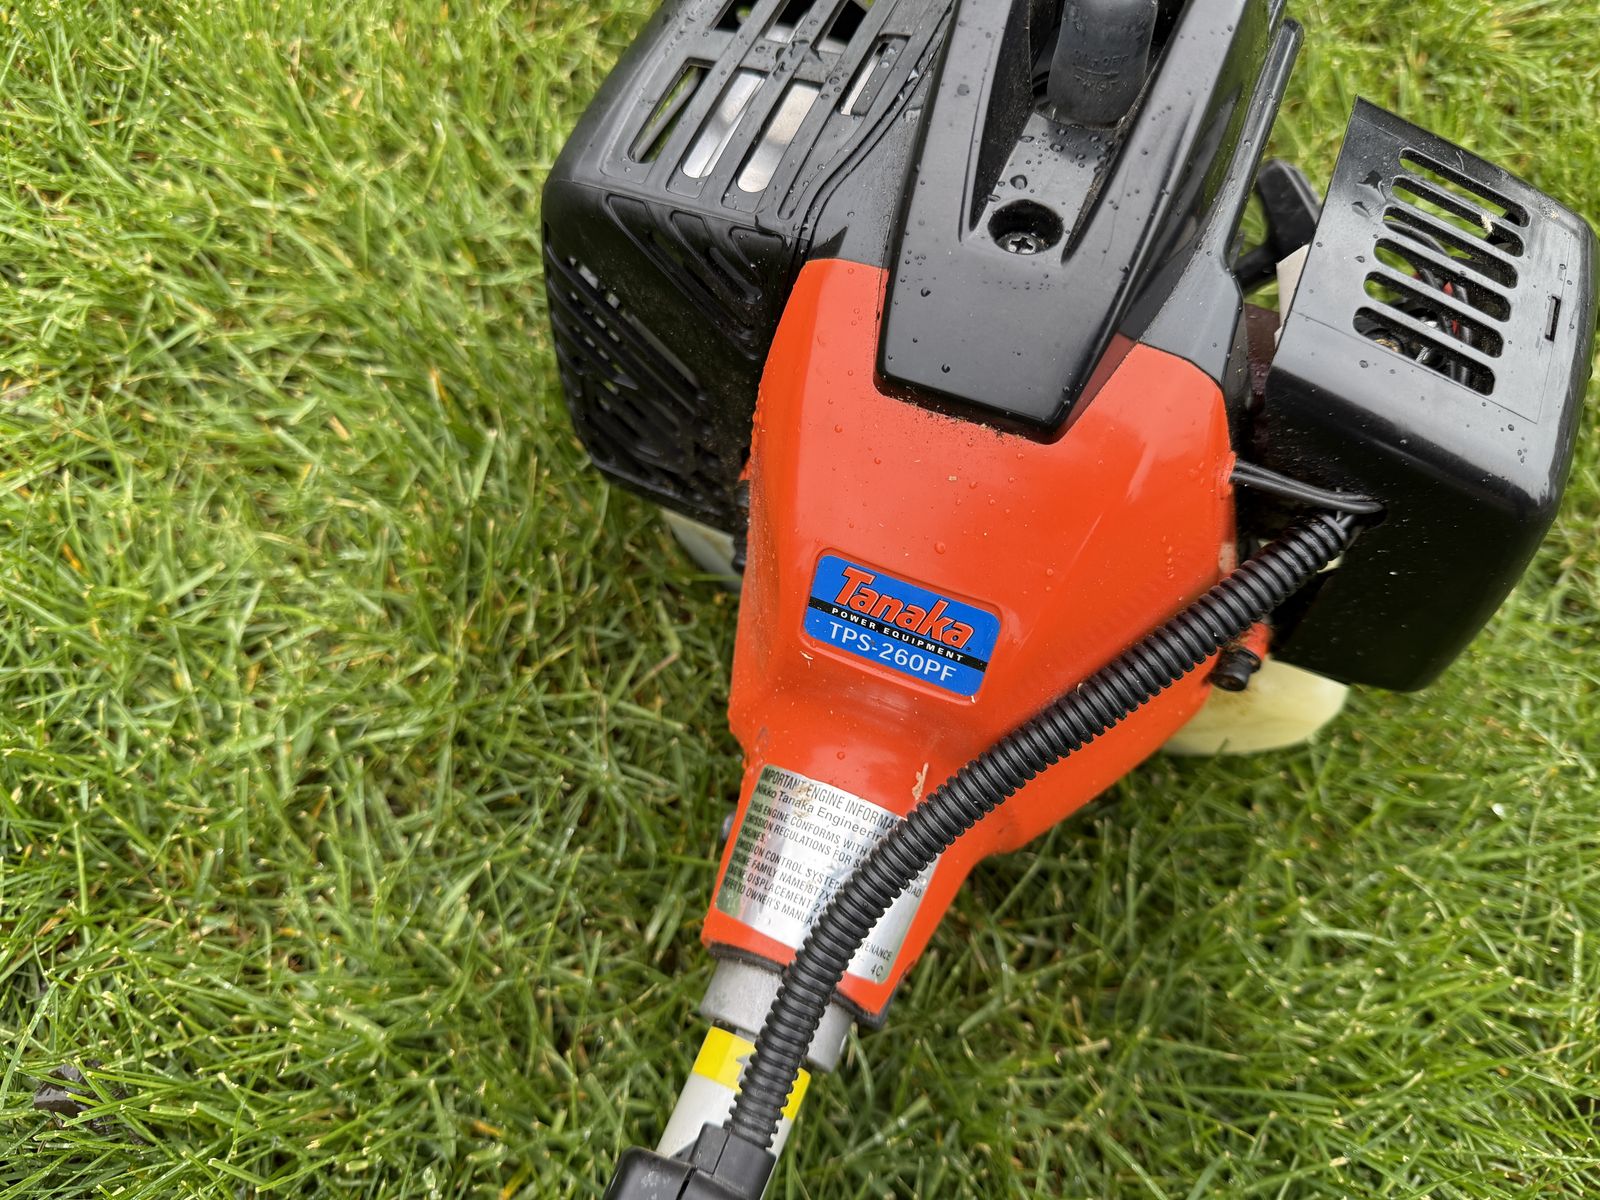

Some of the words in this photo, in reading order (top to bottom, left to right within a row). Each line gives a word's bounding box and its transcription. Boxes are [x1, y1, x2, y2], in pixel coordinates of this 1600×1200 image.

[834, 566, 975, 649] Tanaka
[829, 621, 957, 682] TPS-260PF
[831, 607, 876, 630] POWER
[883, 627, 963, 662] EQUIPMENT
[757, 783, 777, 799] Nikko
[778, 790, 814, 813] Tanaka
[817, 806, 881, 841] Engineerin
[762, 767, 806, 792] IMPORTANT
[806, 783, 845, 809] ENGINE
[844, 799, 897, 830] INFORMA
[763, 805, 790, 823] ENGINE
[790, 816, 841, 845] CONFORMS
[843, 838, 868, 857] WITH
[774, 824, 831, 856] REGULATIONS
[833, 849, 852, 865] FOR
[751, 860, 777, 878] FAMILY
[764, 849, 803, 874] CONTROL
[745, 887, 781, 911] OWNER'S
[746, 872, 813, 909] DISPLACEMENT
[870, 963, 884, 977] 4C
